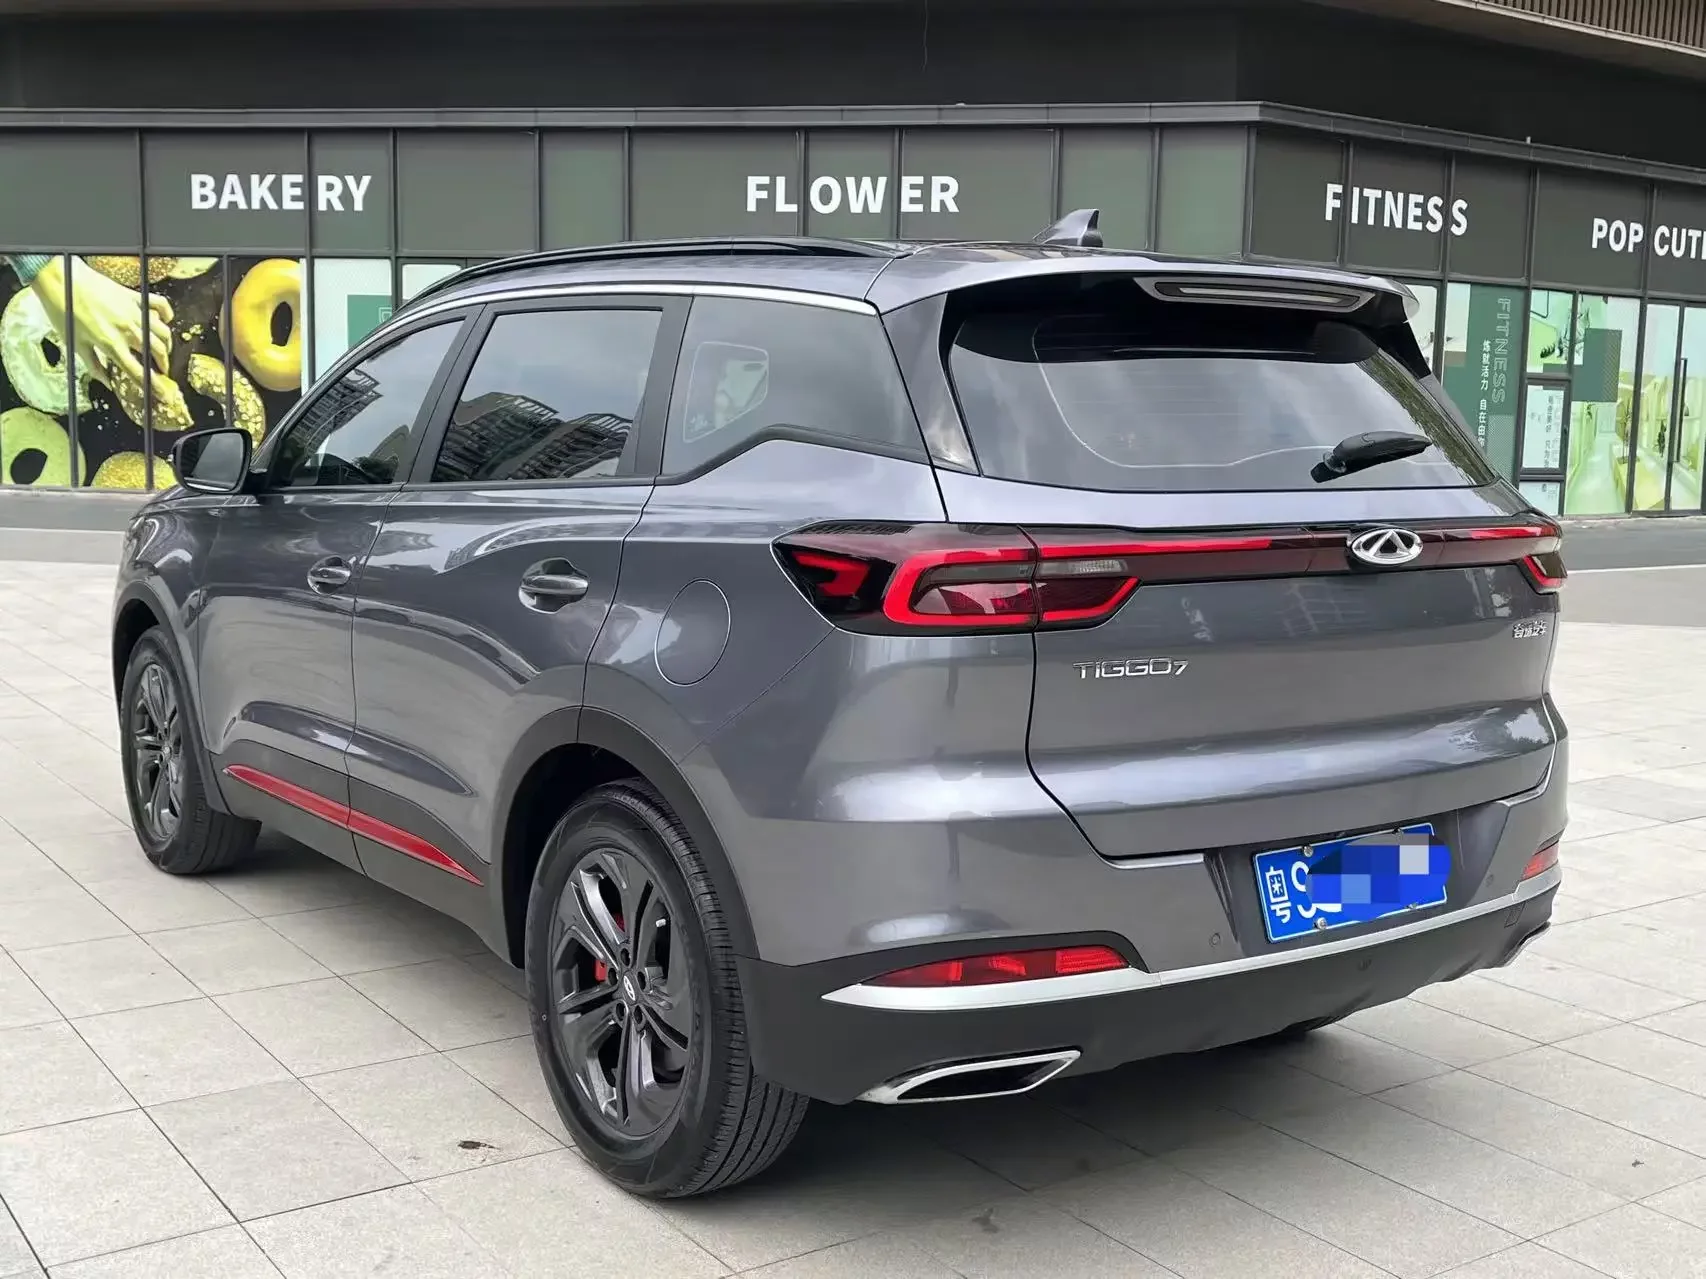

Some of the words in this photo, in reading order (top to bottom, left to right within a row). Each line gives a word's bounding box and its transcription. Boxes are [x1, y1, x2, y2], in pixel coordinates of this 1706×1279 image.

[190, 173, 372, 212] BAKERY
[746, 175, 960, 215] FLOWER
[1325, 183, 1469, 236] FITNESS
[1591, 217, 1644, 253] POP
[1491, 297, 1511, 403] FITNESS
